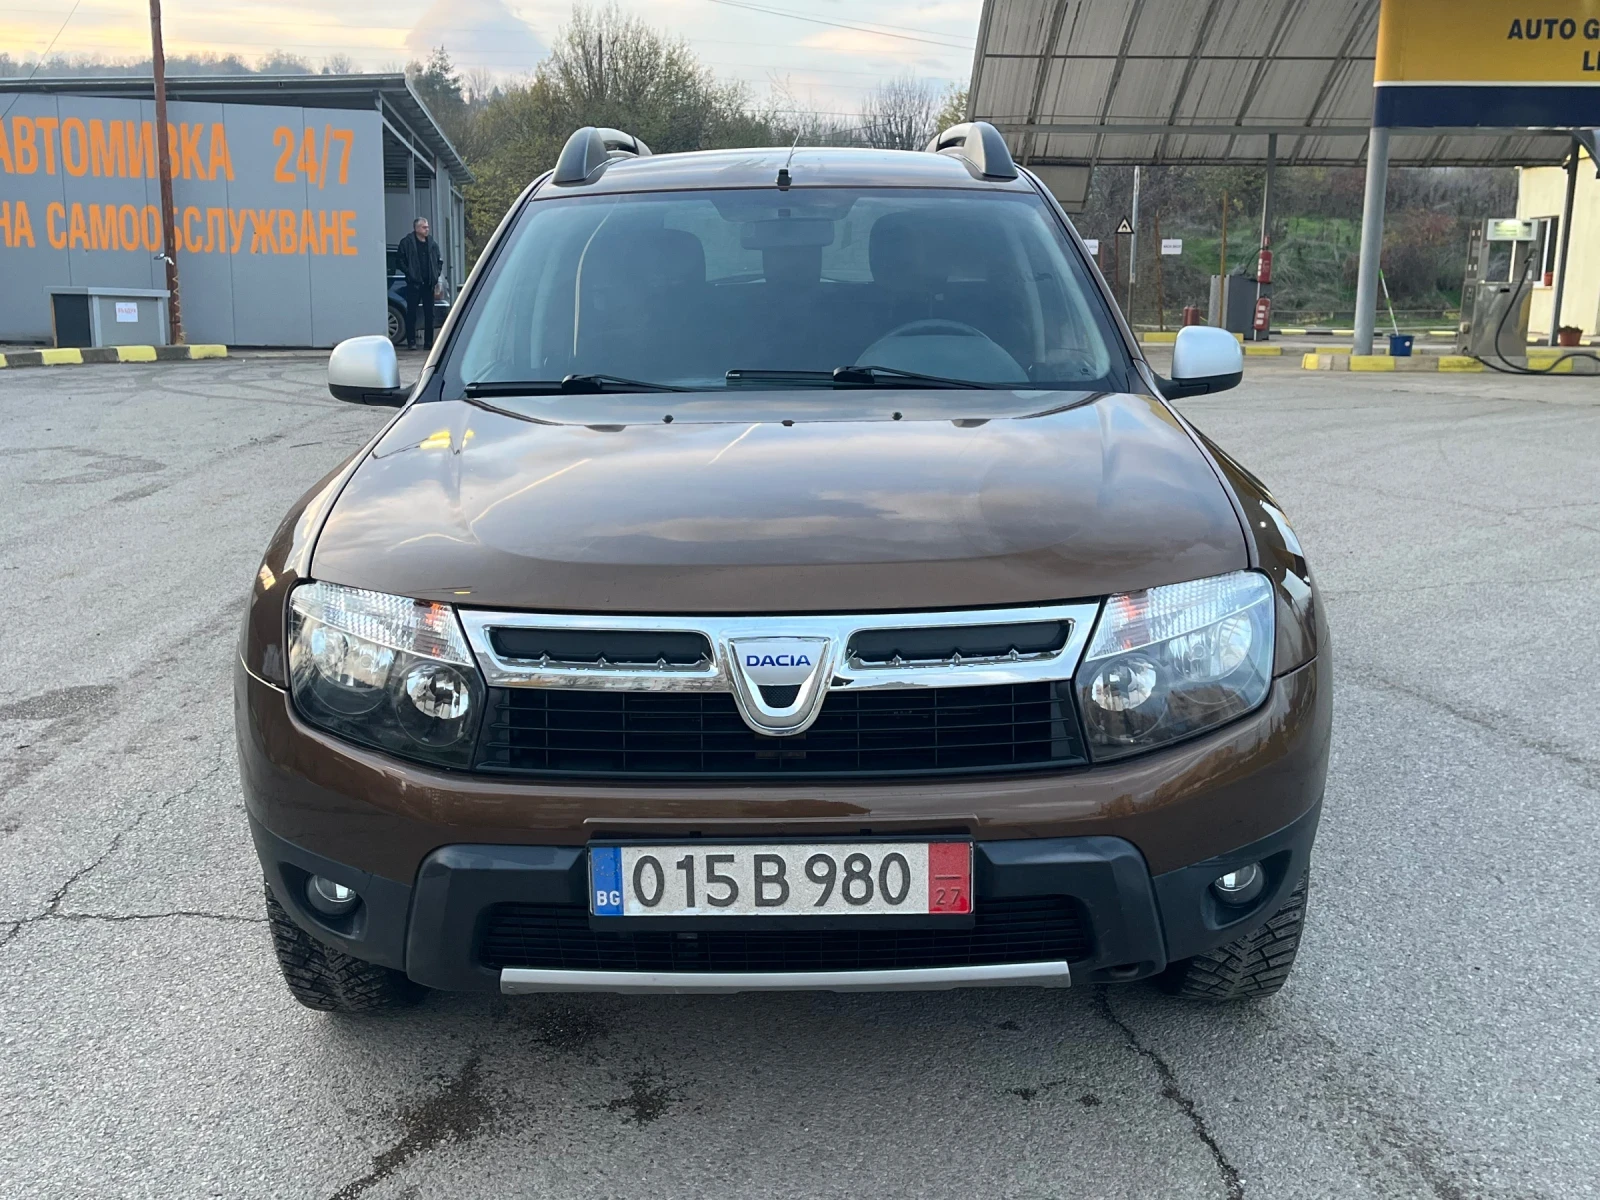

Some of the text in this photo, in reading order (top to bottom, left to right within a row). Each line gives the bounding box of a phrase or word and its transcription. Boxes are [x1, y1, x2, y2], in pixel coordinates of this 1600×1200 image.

[1507, 18, 1576, 40] AUTO
[1582, 50, 1600, 71] L
[273, 124, 354, 190] 24/7
[746, 655, 811, 667] DACIA
[596, 890, 620, 906] BG
[935, 886, 961, 906] 27
